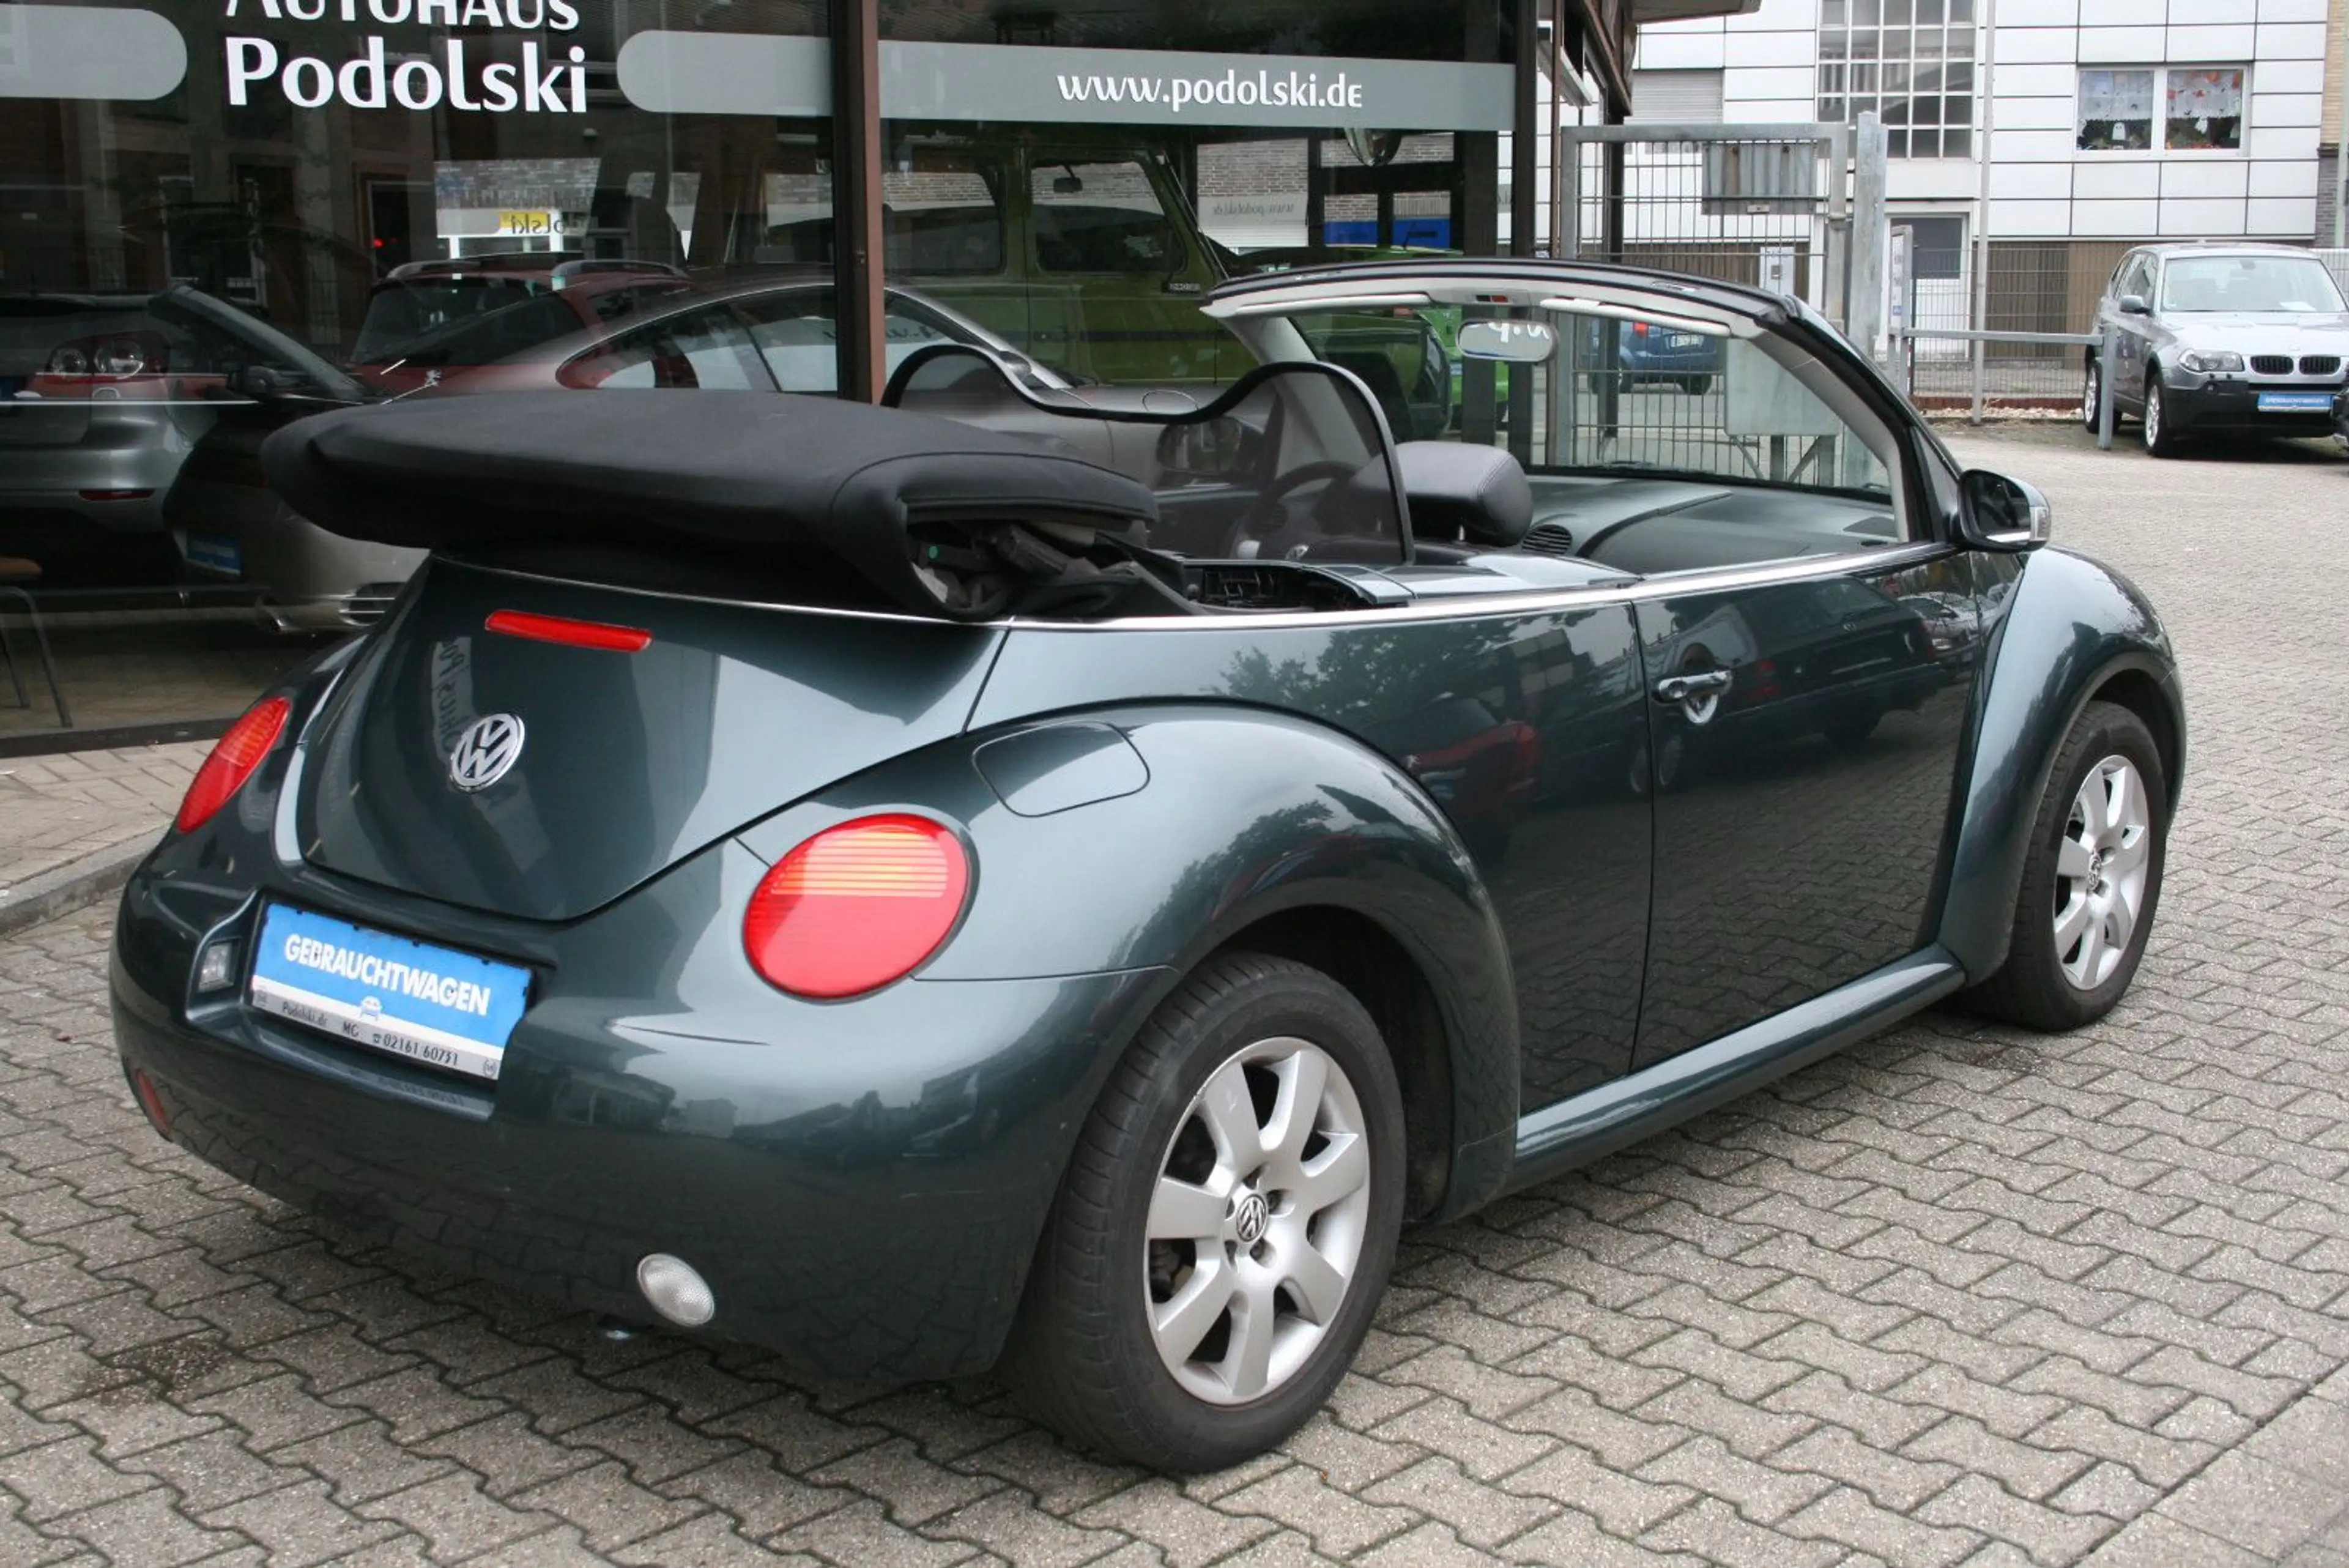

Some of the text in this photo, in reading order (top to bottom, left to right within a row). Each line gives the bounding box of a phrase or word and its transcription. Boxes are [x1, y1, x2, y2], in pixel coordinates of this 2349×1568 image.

[225, 35, 587, 113] Podolski
[284, 933, 492, 1016] GEBRAUCHTWAGEN
[384, 1033, 418, 1055] 02161
